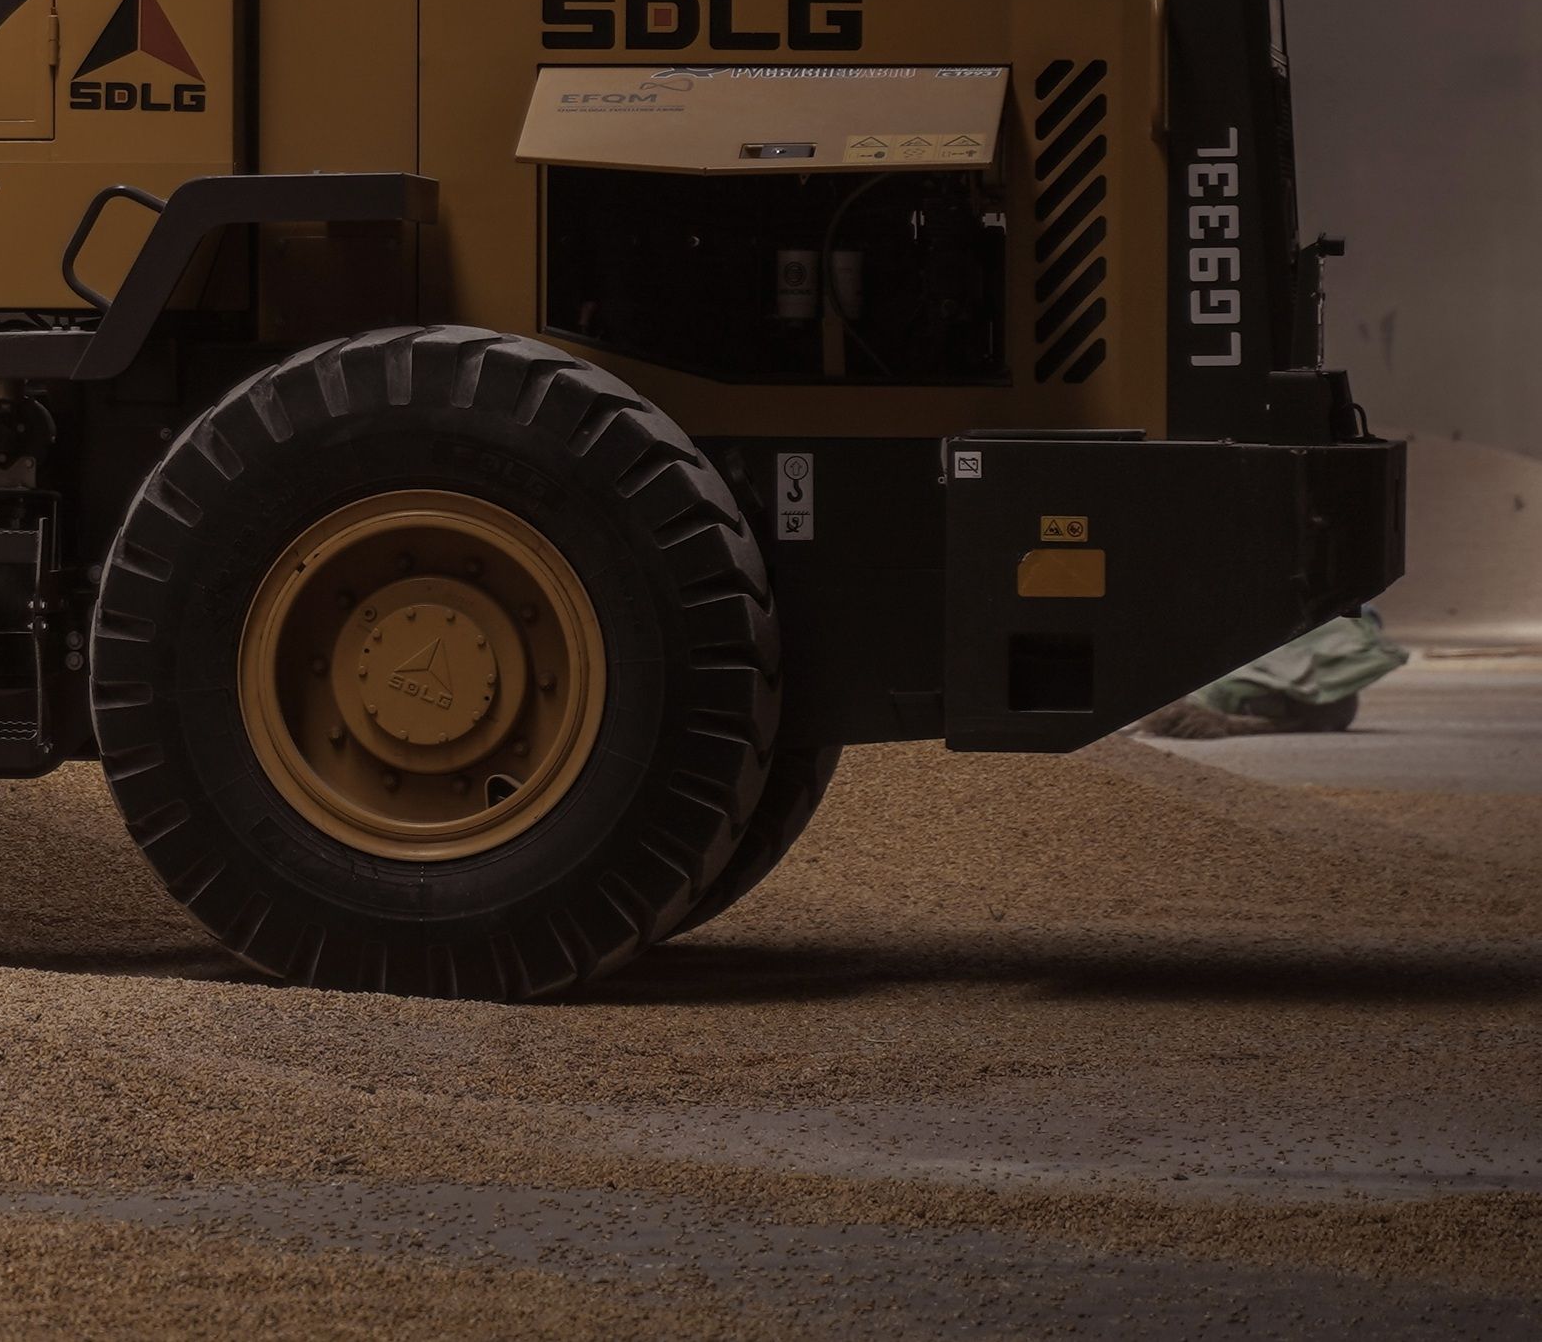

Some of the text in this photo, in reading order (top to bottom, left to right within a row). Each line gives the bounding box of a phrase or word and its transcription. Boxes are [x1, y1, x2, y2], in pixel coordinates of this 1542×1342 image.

[70, 81, 205, 112] SDLG
[561, 93, 658, 104] EFQM
[1188, 126, 1242, 367] LG933L
[387, 672, 454, 711] SDLG
